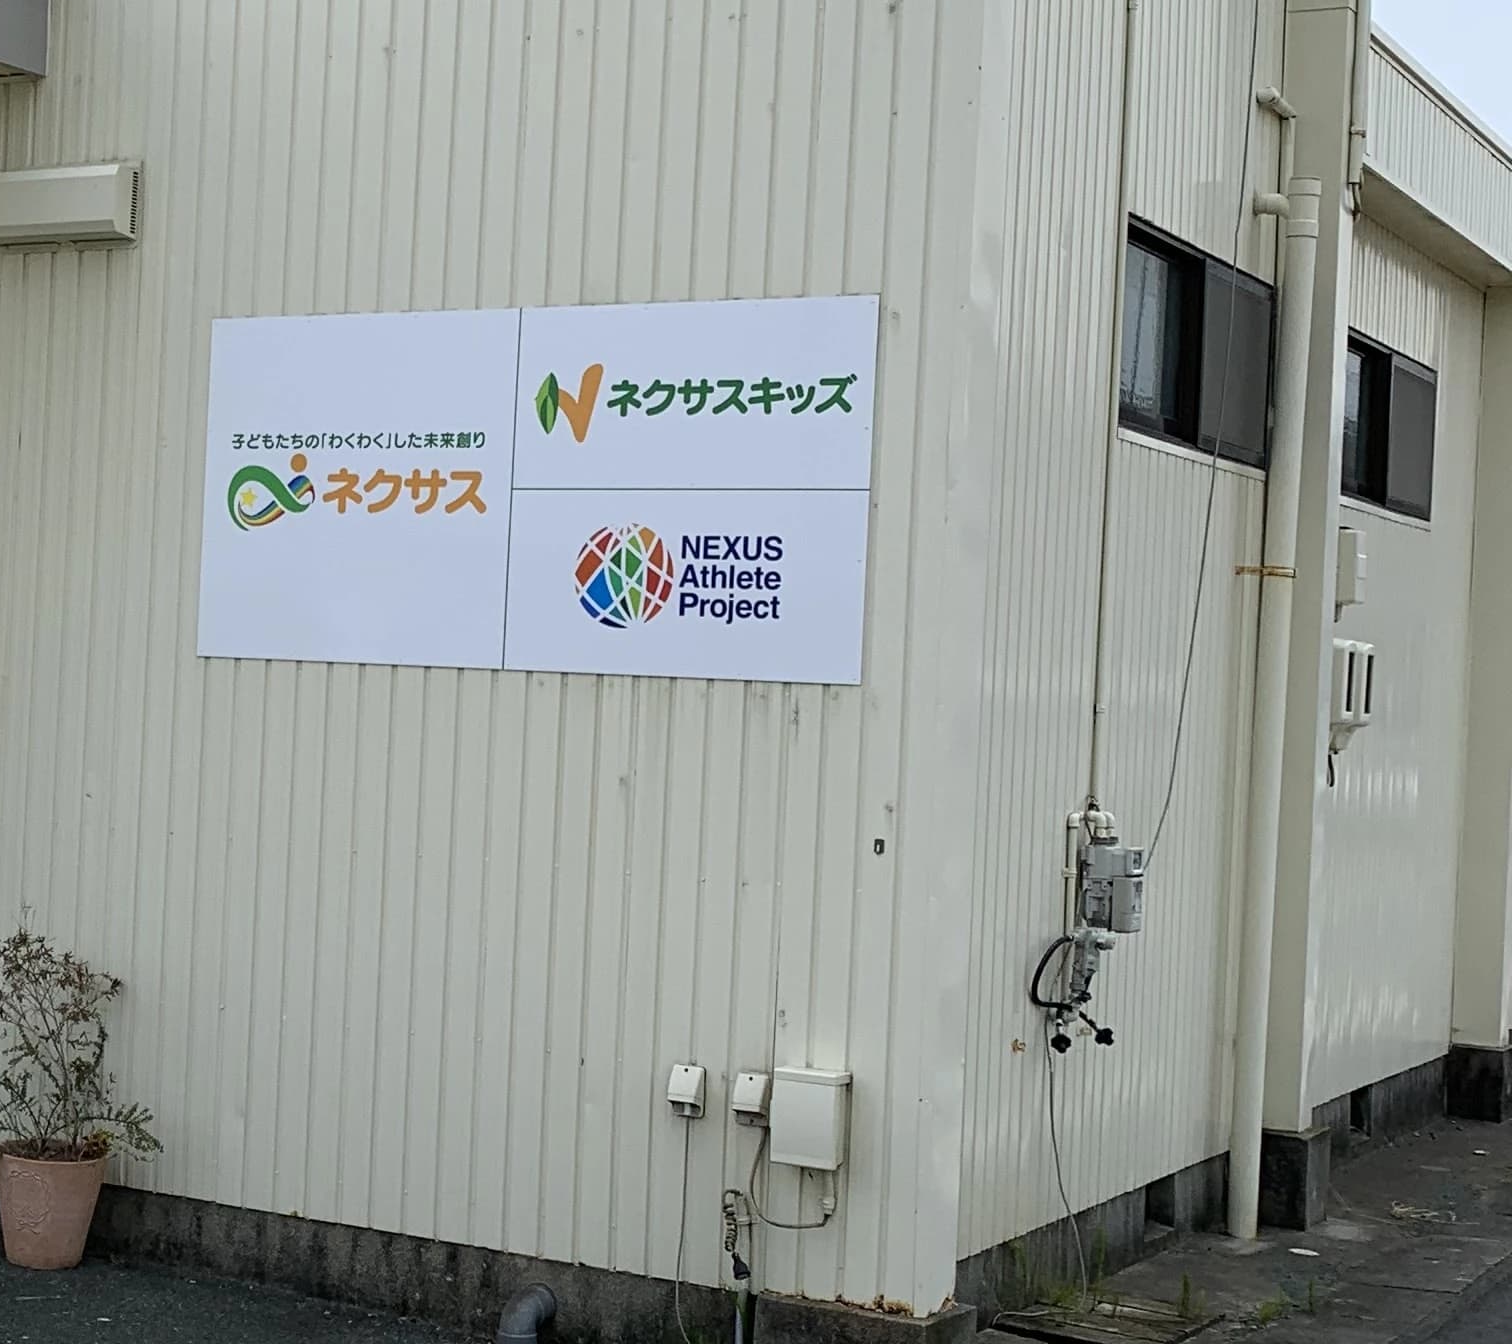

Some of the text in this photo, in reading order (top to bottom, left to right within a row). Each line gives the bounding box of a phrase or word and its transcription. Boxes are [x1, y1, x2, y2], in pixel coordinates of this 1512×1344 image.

[606, 372, 858, 416] ネクサスキッズ
[231, 431, 486, 450] 子どもたちの「わくわく」した未来創り
[322, 467, 487, 514] ネクサス
[681, 535, 784, 562] NEXUS
[679, 564, 782, 590] Athlete
[678, 592, 781, 625] Project
